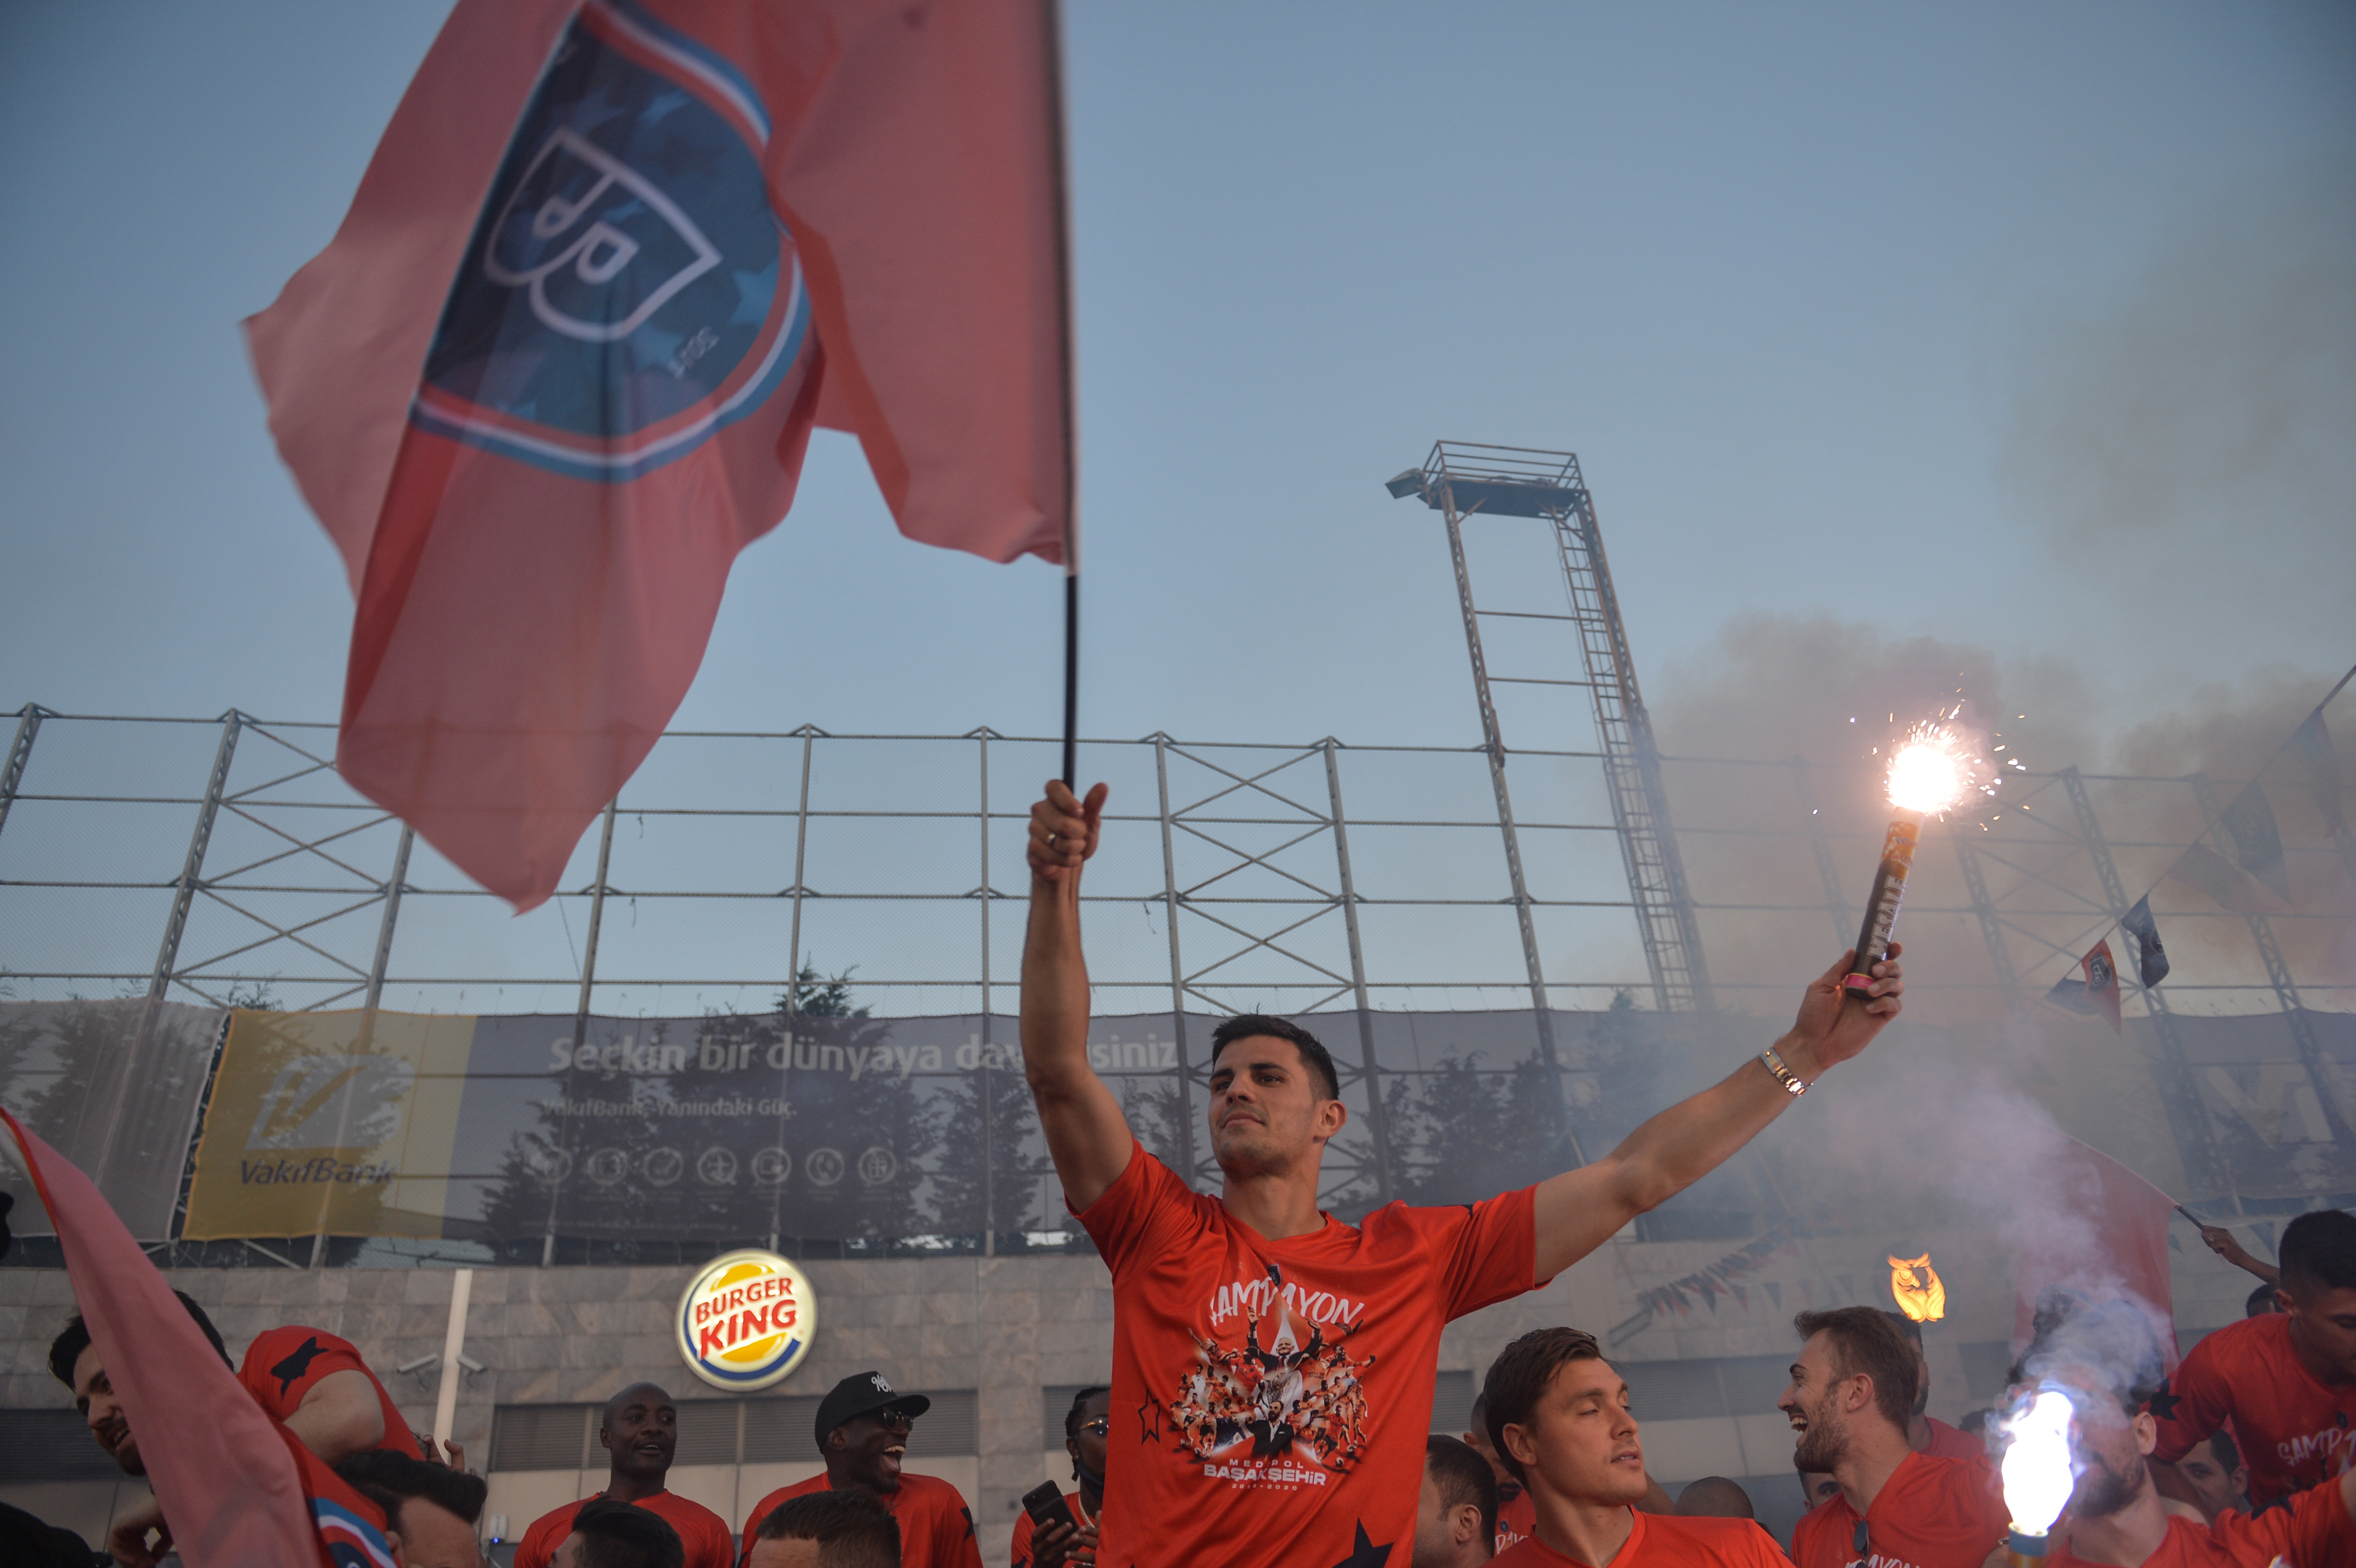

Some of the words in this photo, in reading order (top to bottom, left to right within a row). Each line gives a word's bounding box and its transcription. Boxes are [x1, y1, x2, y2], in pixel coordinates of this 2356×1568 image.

[550, 1036, 686, 1081] Seçkin
[699, 1034, 757, 1071] bir
[766, 1031, 942, 1081] dünyaya
[696, 1277, 794, 1326] BURGER
[700, 1299, 797, 1360] KING
